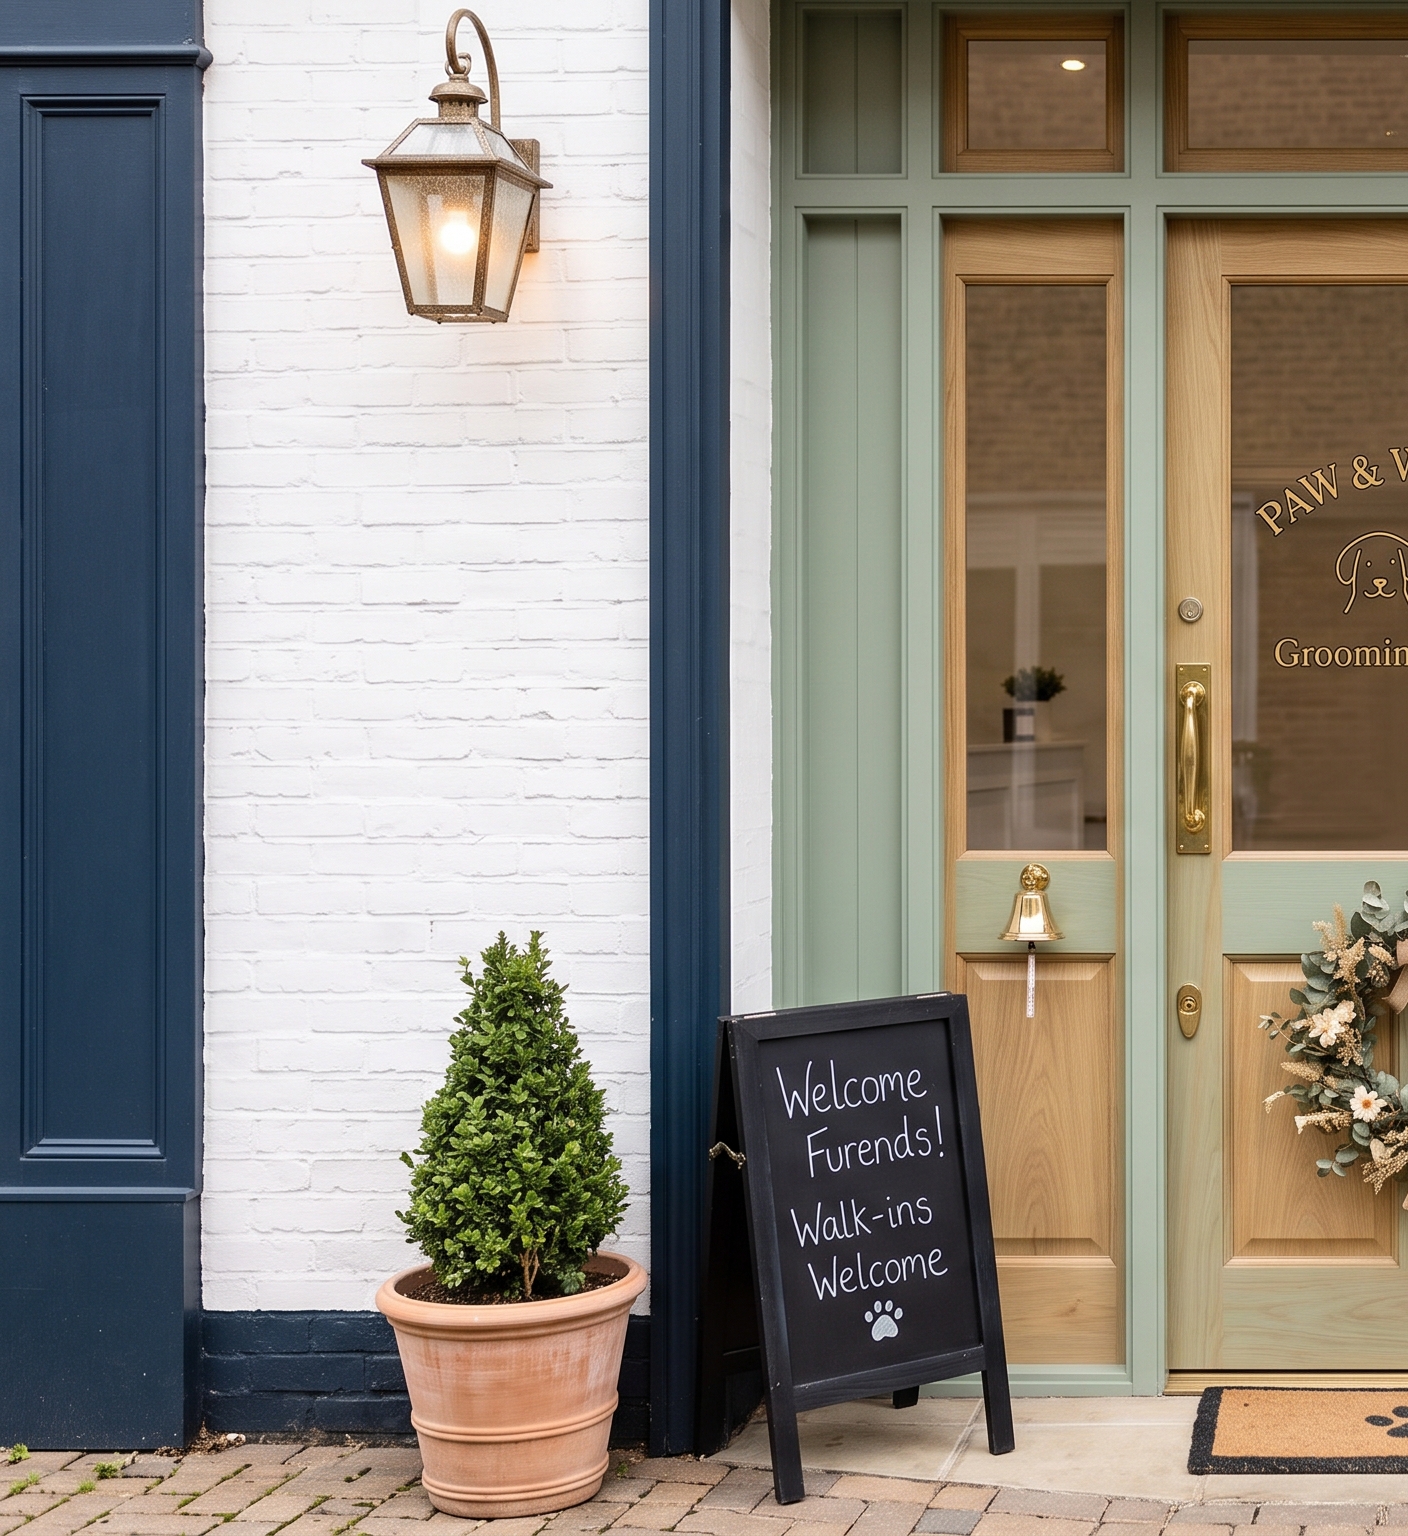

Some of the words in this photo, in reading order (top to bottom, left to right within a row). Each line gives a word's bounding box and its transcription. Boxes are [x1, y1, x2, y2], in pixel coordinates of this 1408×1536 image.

[1256, 463, 1338, 536] PAW
[1352, 455, 1384, 489] &
[775, 1059, 928, 1119] Welcome
[806, 1105, 944, 1178] Furends!
[790, 1196, 933, 1248] Walk-ins
[807, 1248, 949, 1301] Welcome
